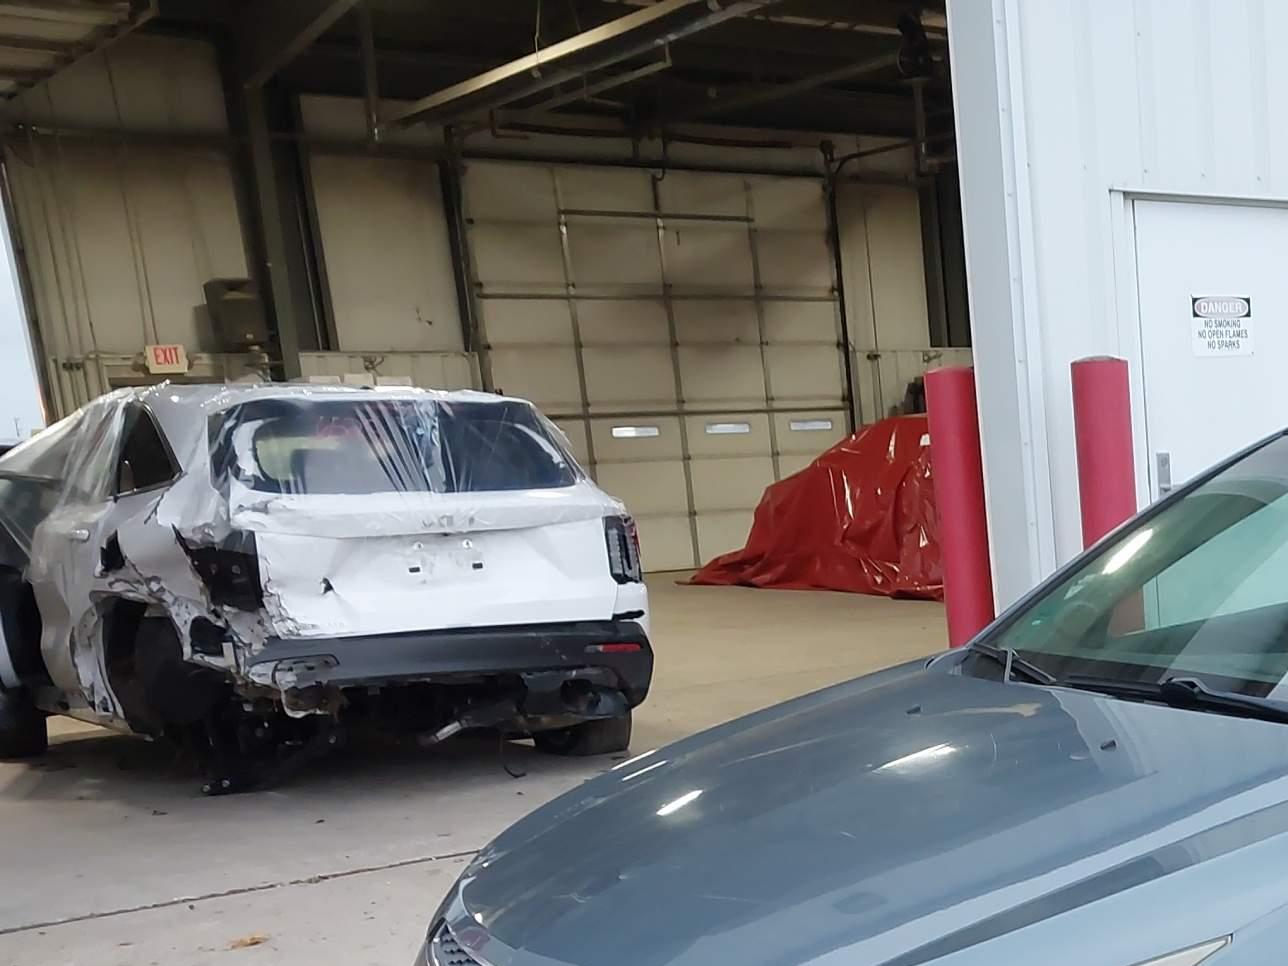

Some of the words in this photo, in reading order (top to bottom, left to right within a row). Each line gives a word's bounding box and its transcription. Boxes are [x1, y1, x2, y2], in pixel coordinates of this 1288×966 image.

[1200, 301, 1243, 313] DANGER
[1204, 319, 1213, 328] NO
[1214, 319, 1241, 328] SMOKING
[1198, 329, 1207, 339] NO
[1208, 329, 1224, 339] OPEN
[1225, 329, 1249, 339] FLAMES
[1207, 340, 1216, 350] NO
[1217, 340, 1240, 350] SPARKS
[153, 347, 179, 365] EXIT
